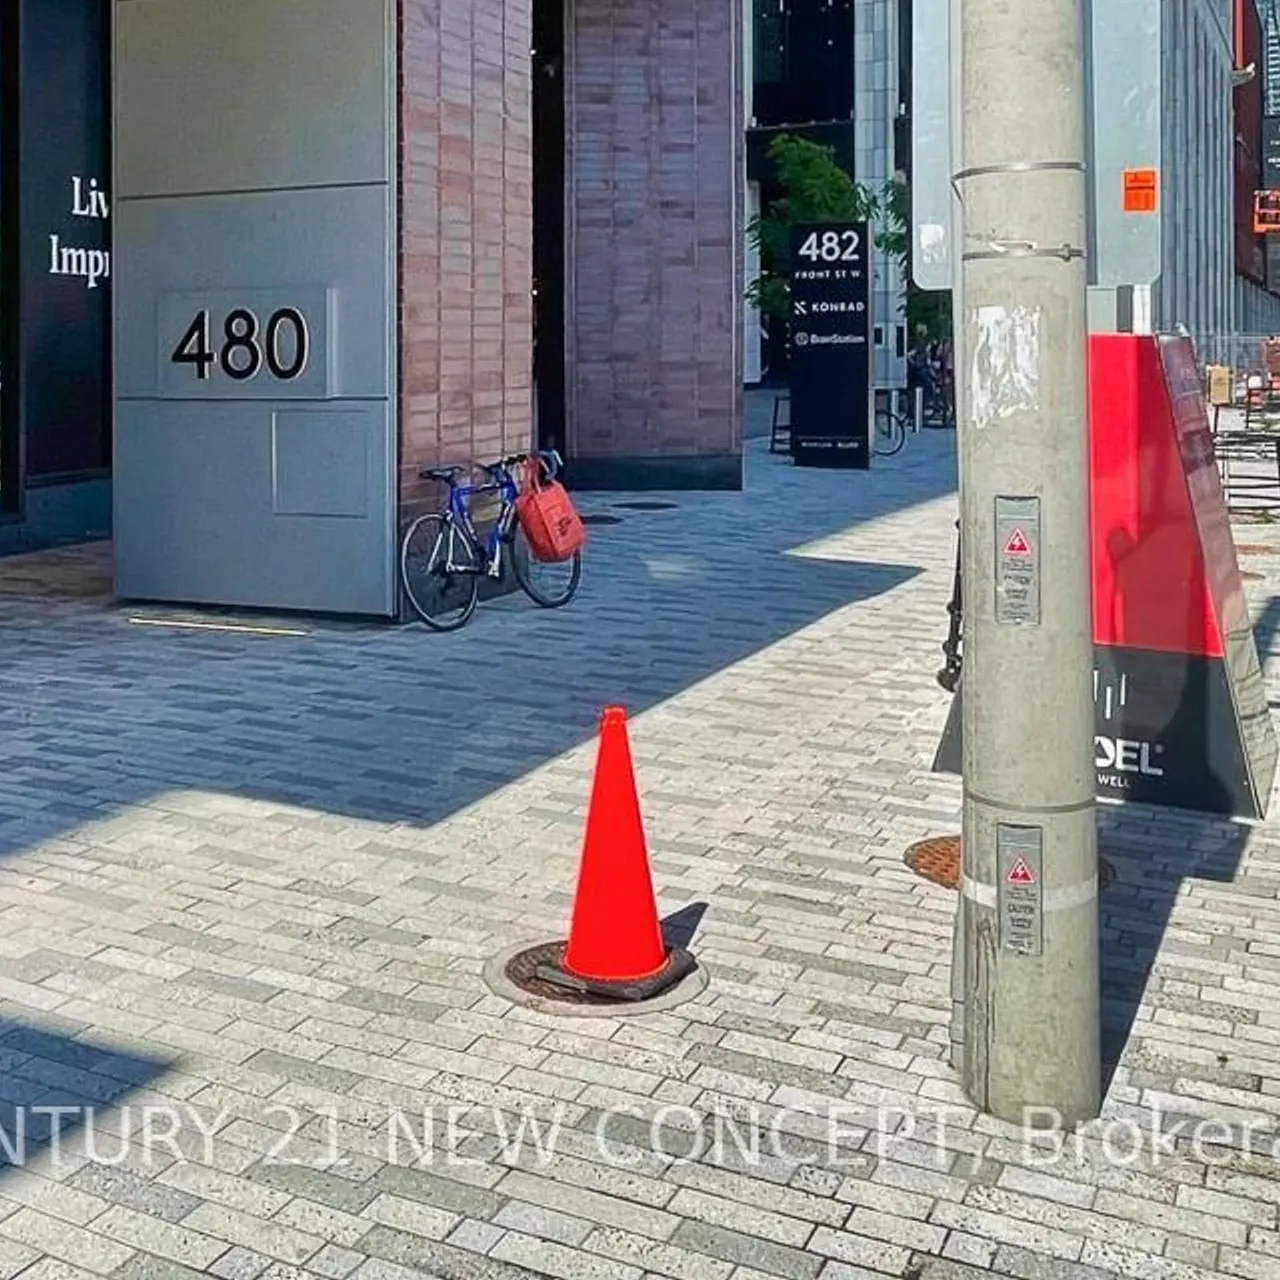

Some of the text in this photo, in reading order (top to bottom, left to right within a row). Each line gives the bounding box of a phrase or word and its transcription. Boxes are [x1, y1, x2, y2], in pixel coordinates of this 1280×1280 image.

[798, 230, 860, 262] 482
[811, 301, 865, 313] KONRAD
[170, 306, 310, 381] 480
